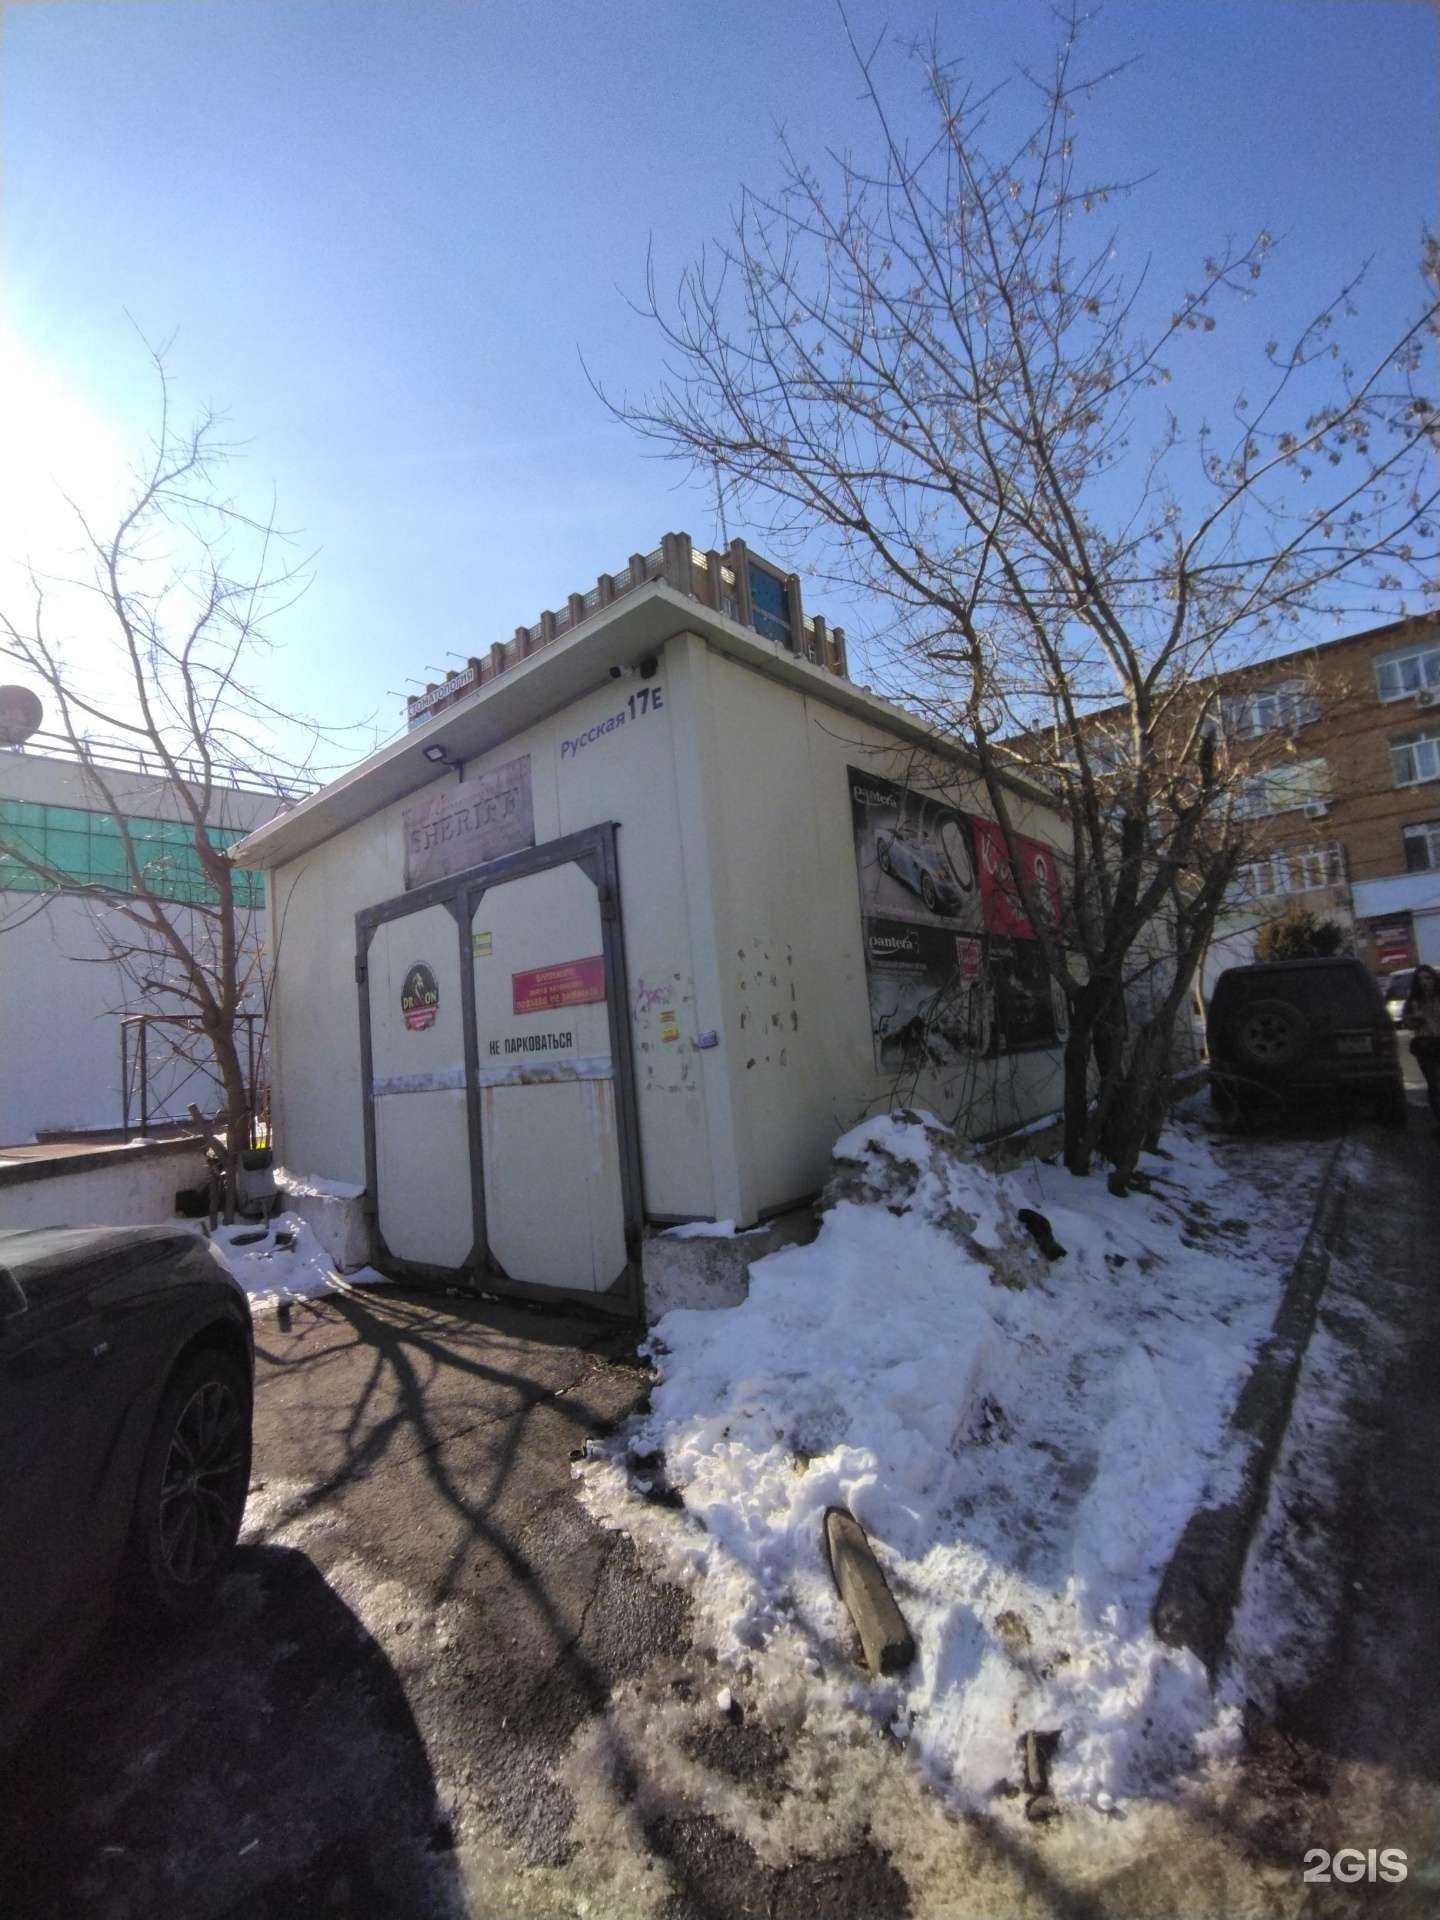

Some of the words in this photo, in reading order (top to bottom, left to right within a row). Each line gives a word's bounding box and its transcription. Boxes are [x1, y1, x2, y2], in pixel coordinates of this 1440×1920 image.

[561, 712, 626, 760] Русская
[628, 687, 664, 720] 17Е
[489, 1040, 500, 1056] НЕ
[504, 1032, 573, 1055] ПАРКОВАТЬСЯ
